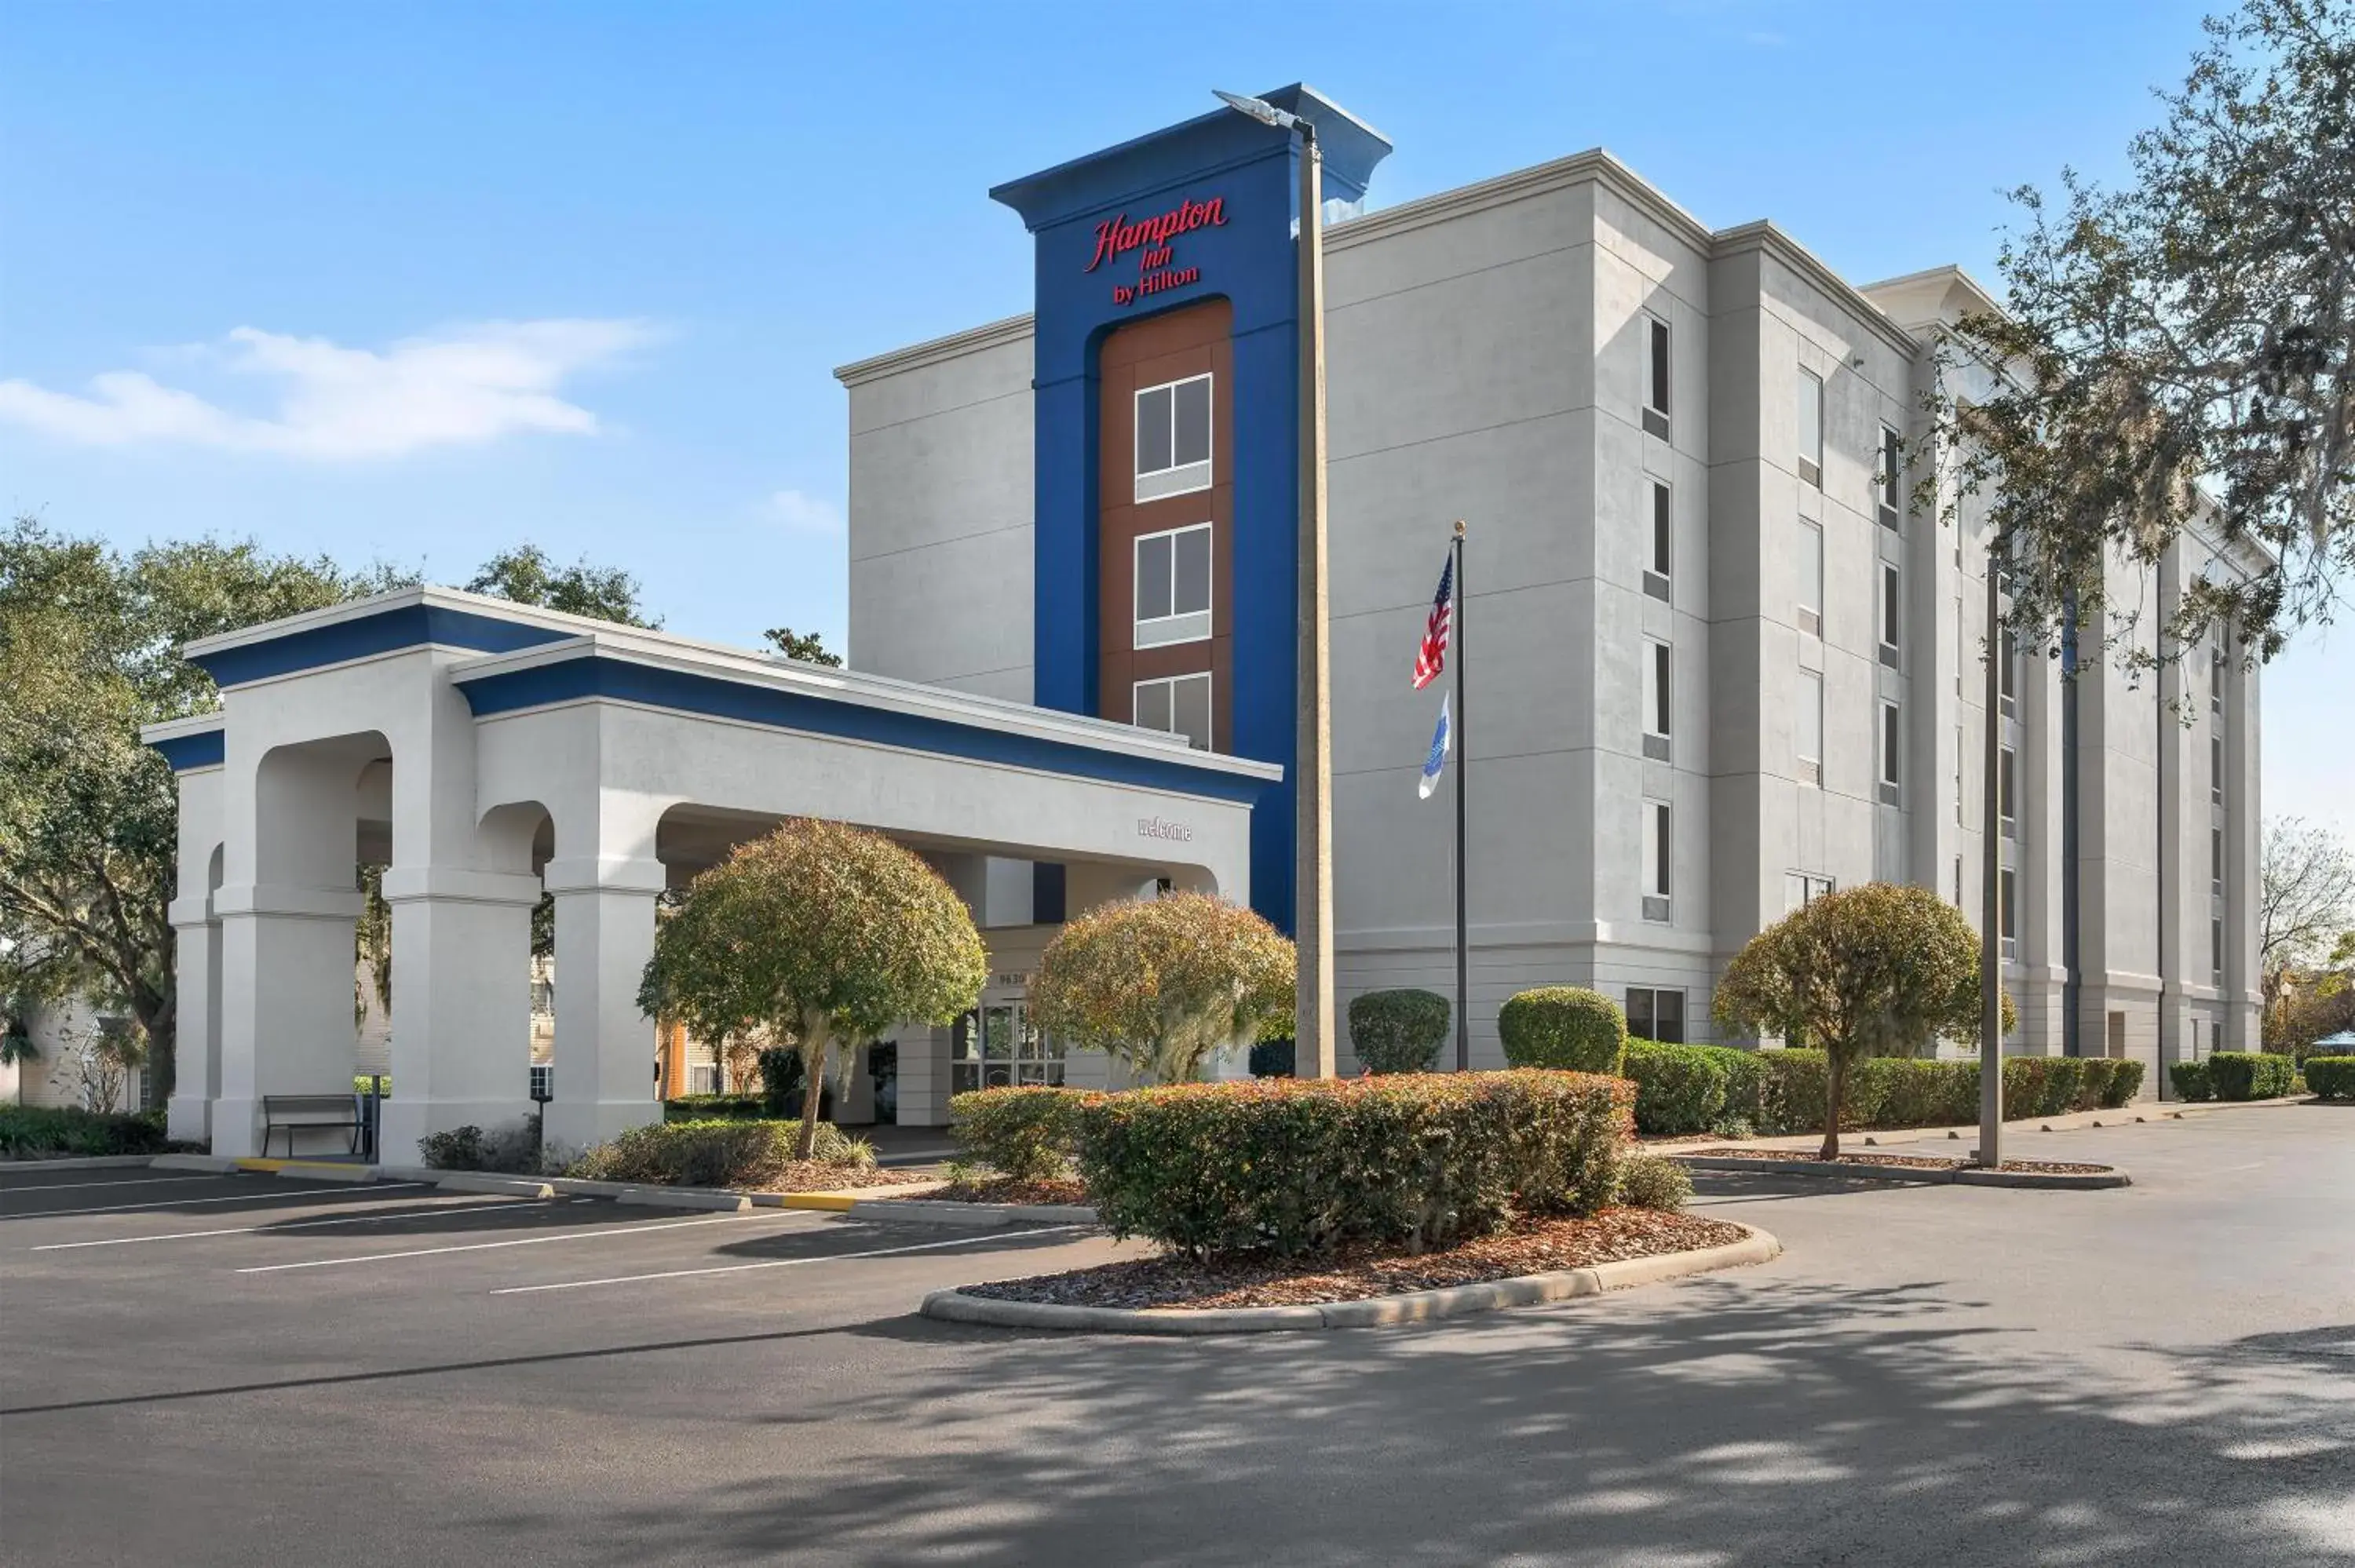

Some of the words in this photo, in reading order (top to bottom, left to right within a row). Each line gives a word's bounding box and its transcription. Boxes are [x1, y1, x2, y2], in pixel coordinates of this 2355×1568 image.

[1083, 197, 1230, 272] Hampton
[1138, 246, 1174, 272] Inn
[1113, 285, 1137, 306] by
[1139, 266, 1199, 296] Hilton
